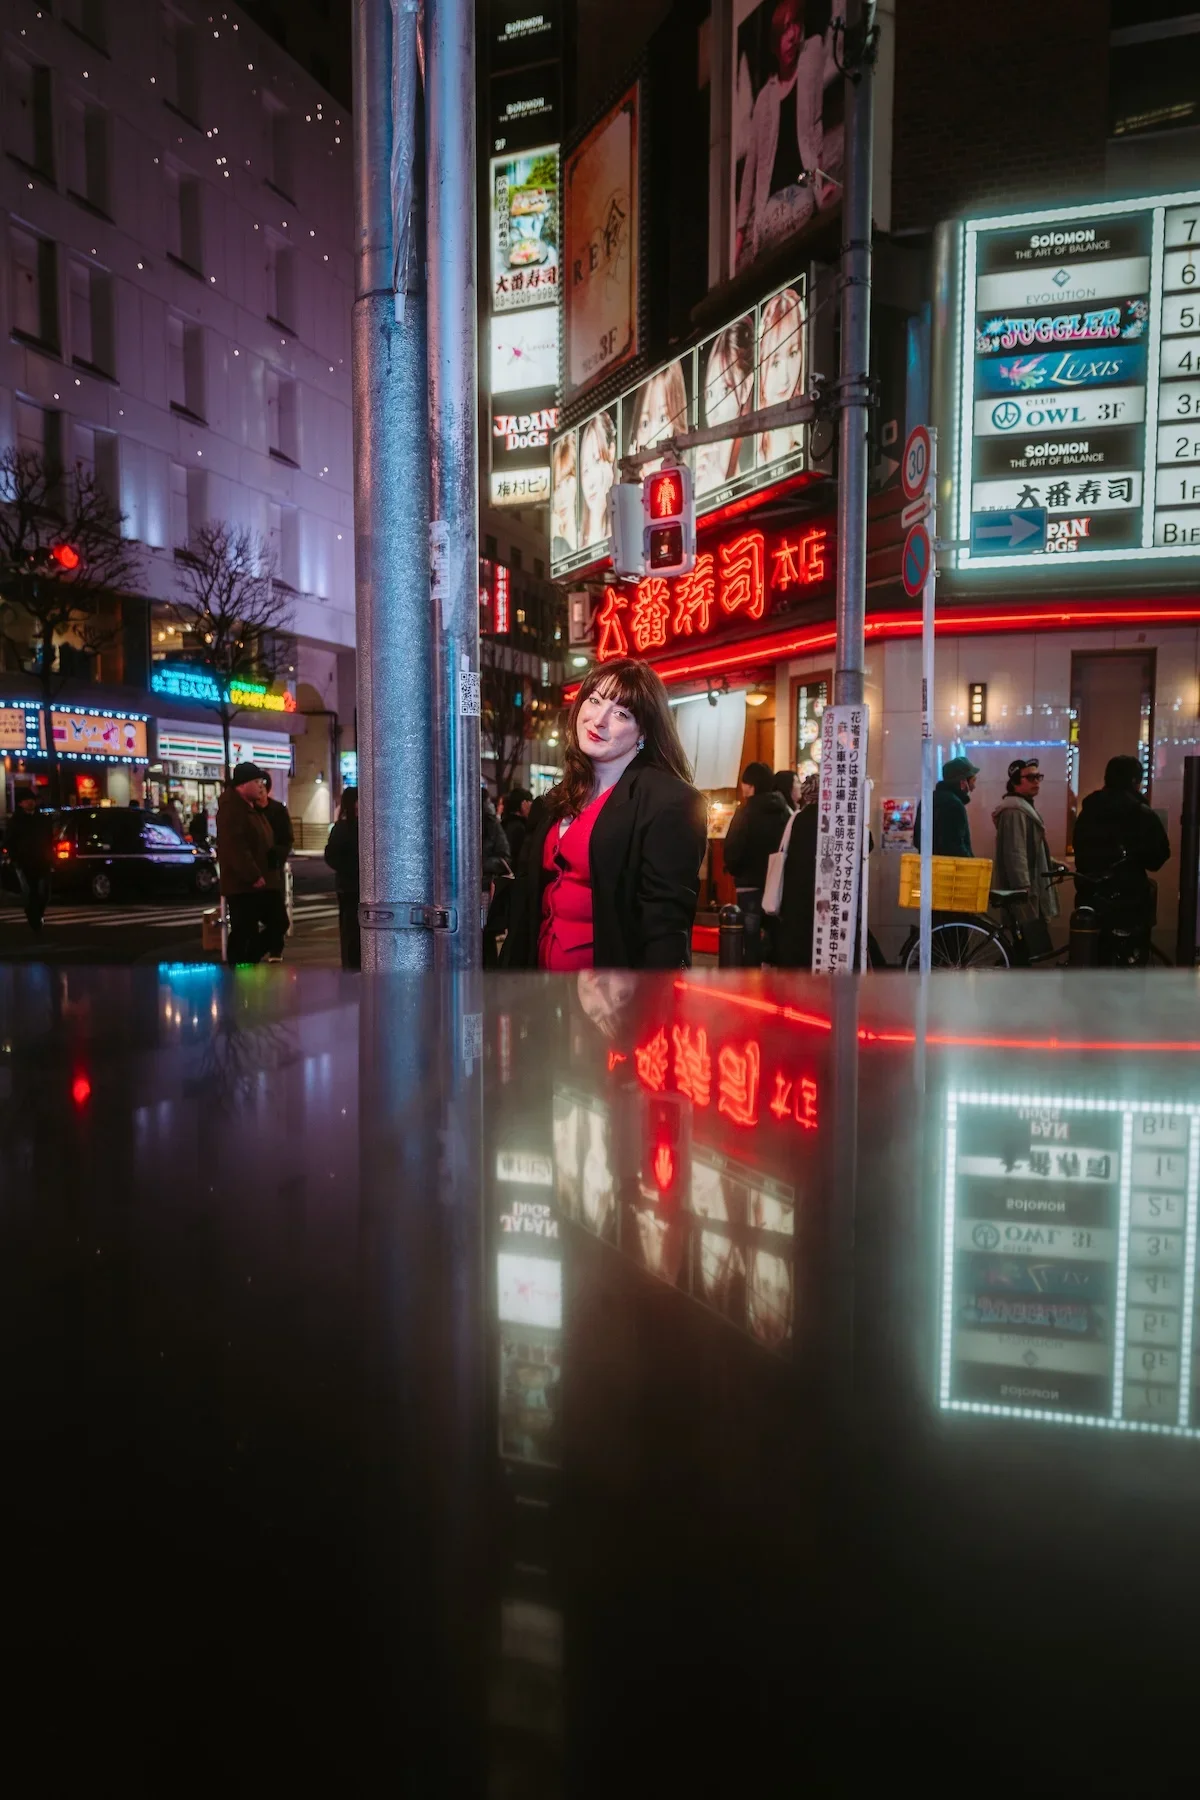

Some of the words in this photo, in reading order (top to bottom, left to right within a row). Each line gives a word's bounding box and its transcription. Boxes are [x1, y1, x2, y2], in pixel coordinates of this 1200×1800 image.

[1015, 250, 1032, 260] THE
[1035, 248, 1051, 258] ART
[1055, 246, 1067, 256] OF
[1069, 240, 1111, 254] BALANCE
[1026, 288, 1096, 305] EVOLUTION
[1001, 307, 1121, 349] JUGGLER
[1180, 307, 1200, 329] 5
[1026, 398, 1057, 407] CLUB
[494, 408, 559, 437] JAPAN
[1026, 407, 1086, 427] OWL
[1098, 402, 1126, 420] 3F
[908, 444, 925, 481] 30
[1010, 458, 1027, 468] THE
[1030, 457, 1047, 467] ART
[1050, 456, 1062, 466] OF
[1063, 453, 1104, 465] BALANCE
[1047, 516, 1091, 539] PAN
[1163, 523, 1200, 544] B1F
